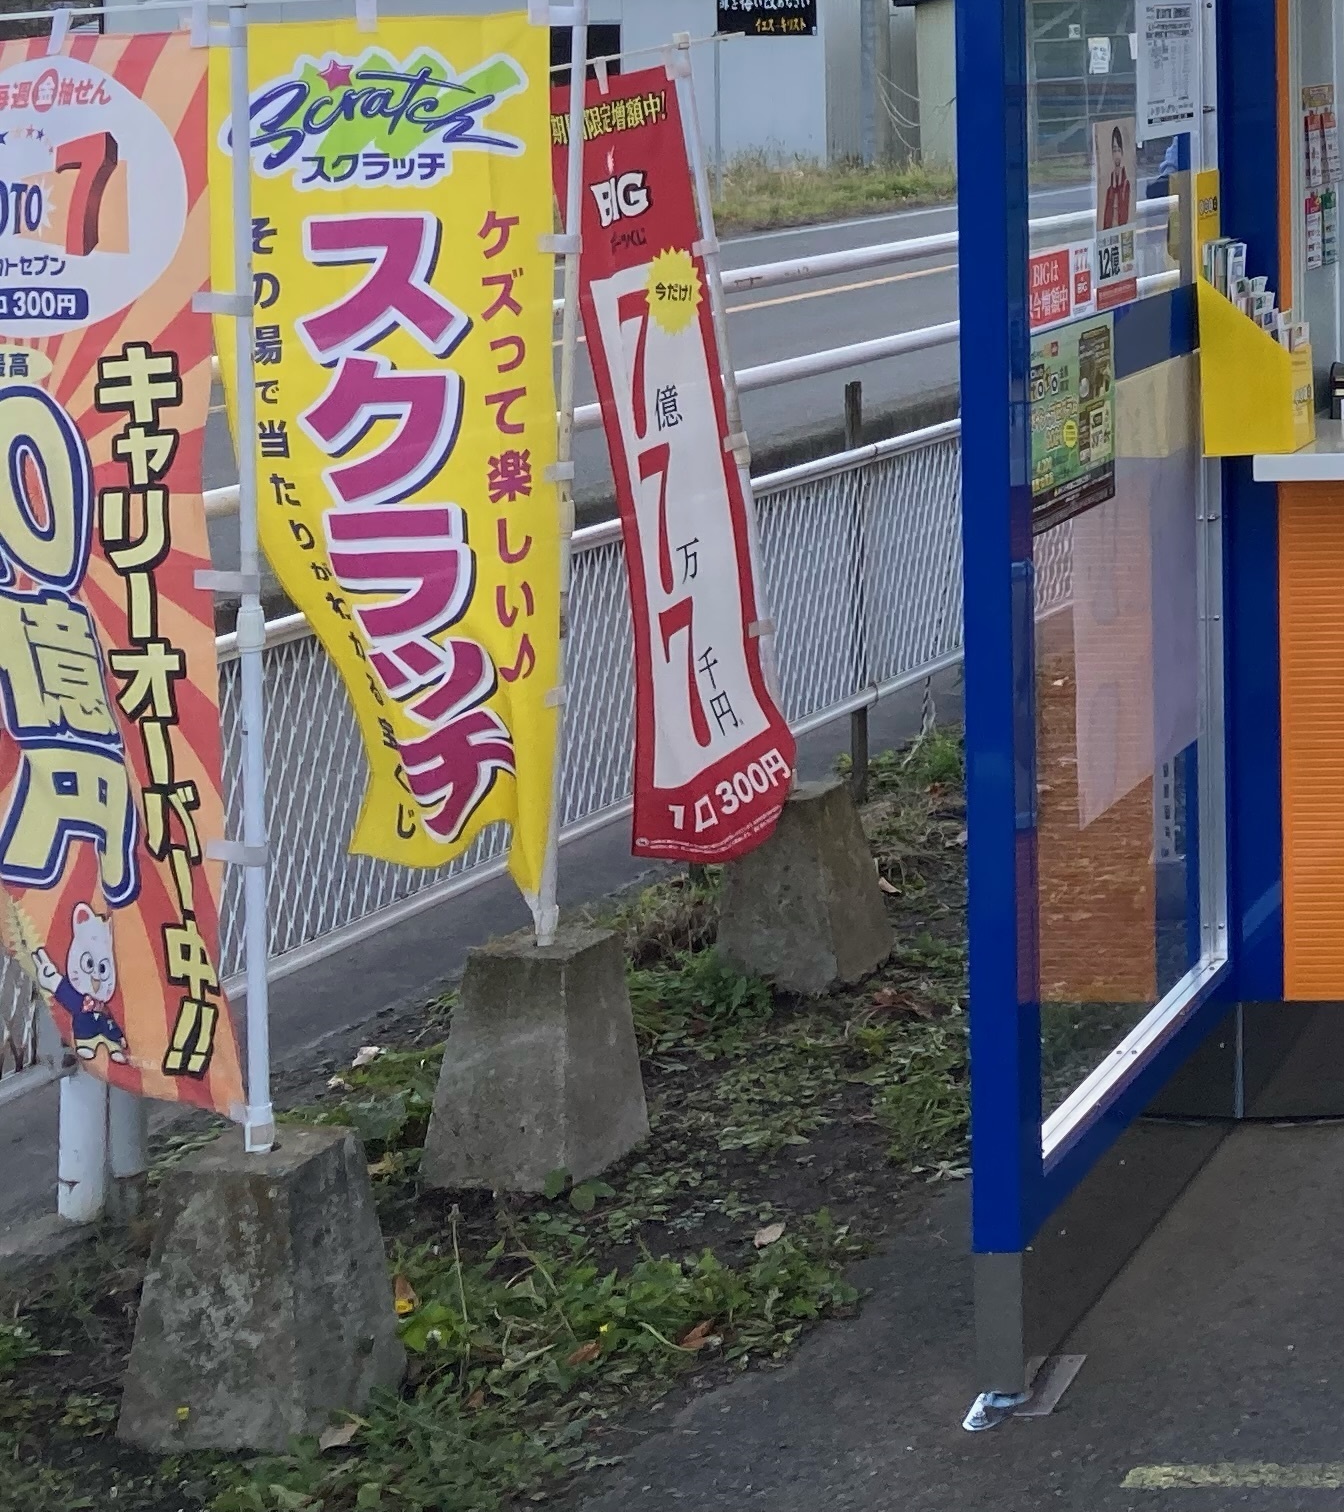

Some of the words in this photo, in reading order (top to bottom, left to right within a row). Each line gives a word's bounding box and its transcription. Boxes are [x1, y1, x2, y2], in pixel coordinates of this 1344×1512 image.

[302, 153, 446, 181] スクラッチ
[591, 171, 653, 228] BIG
[655, 282, 692, 301] 今だけ!
[297, 211, 516, 845] スクラッチ
